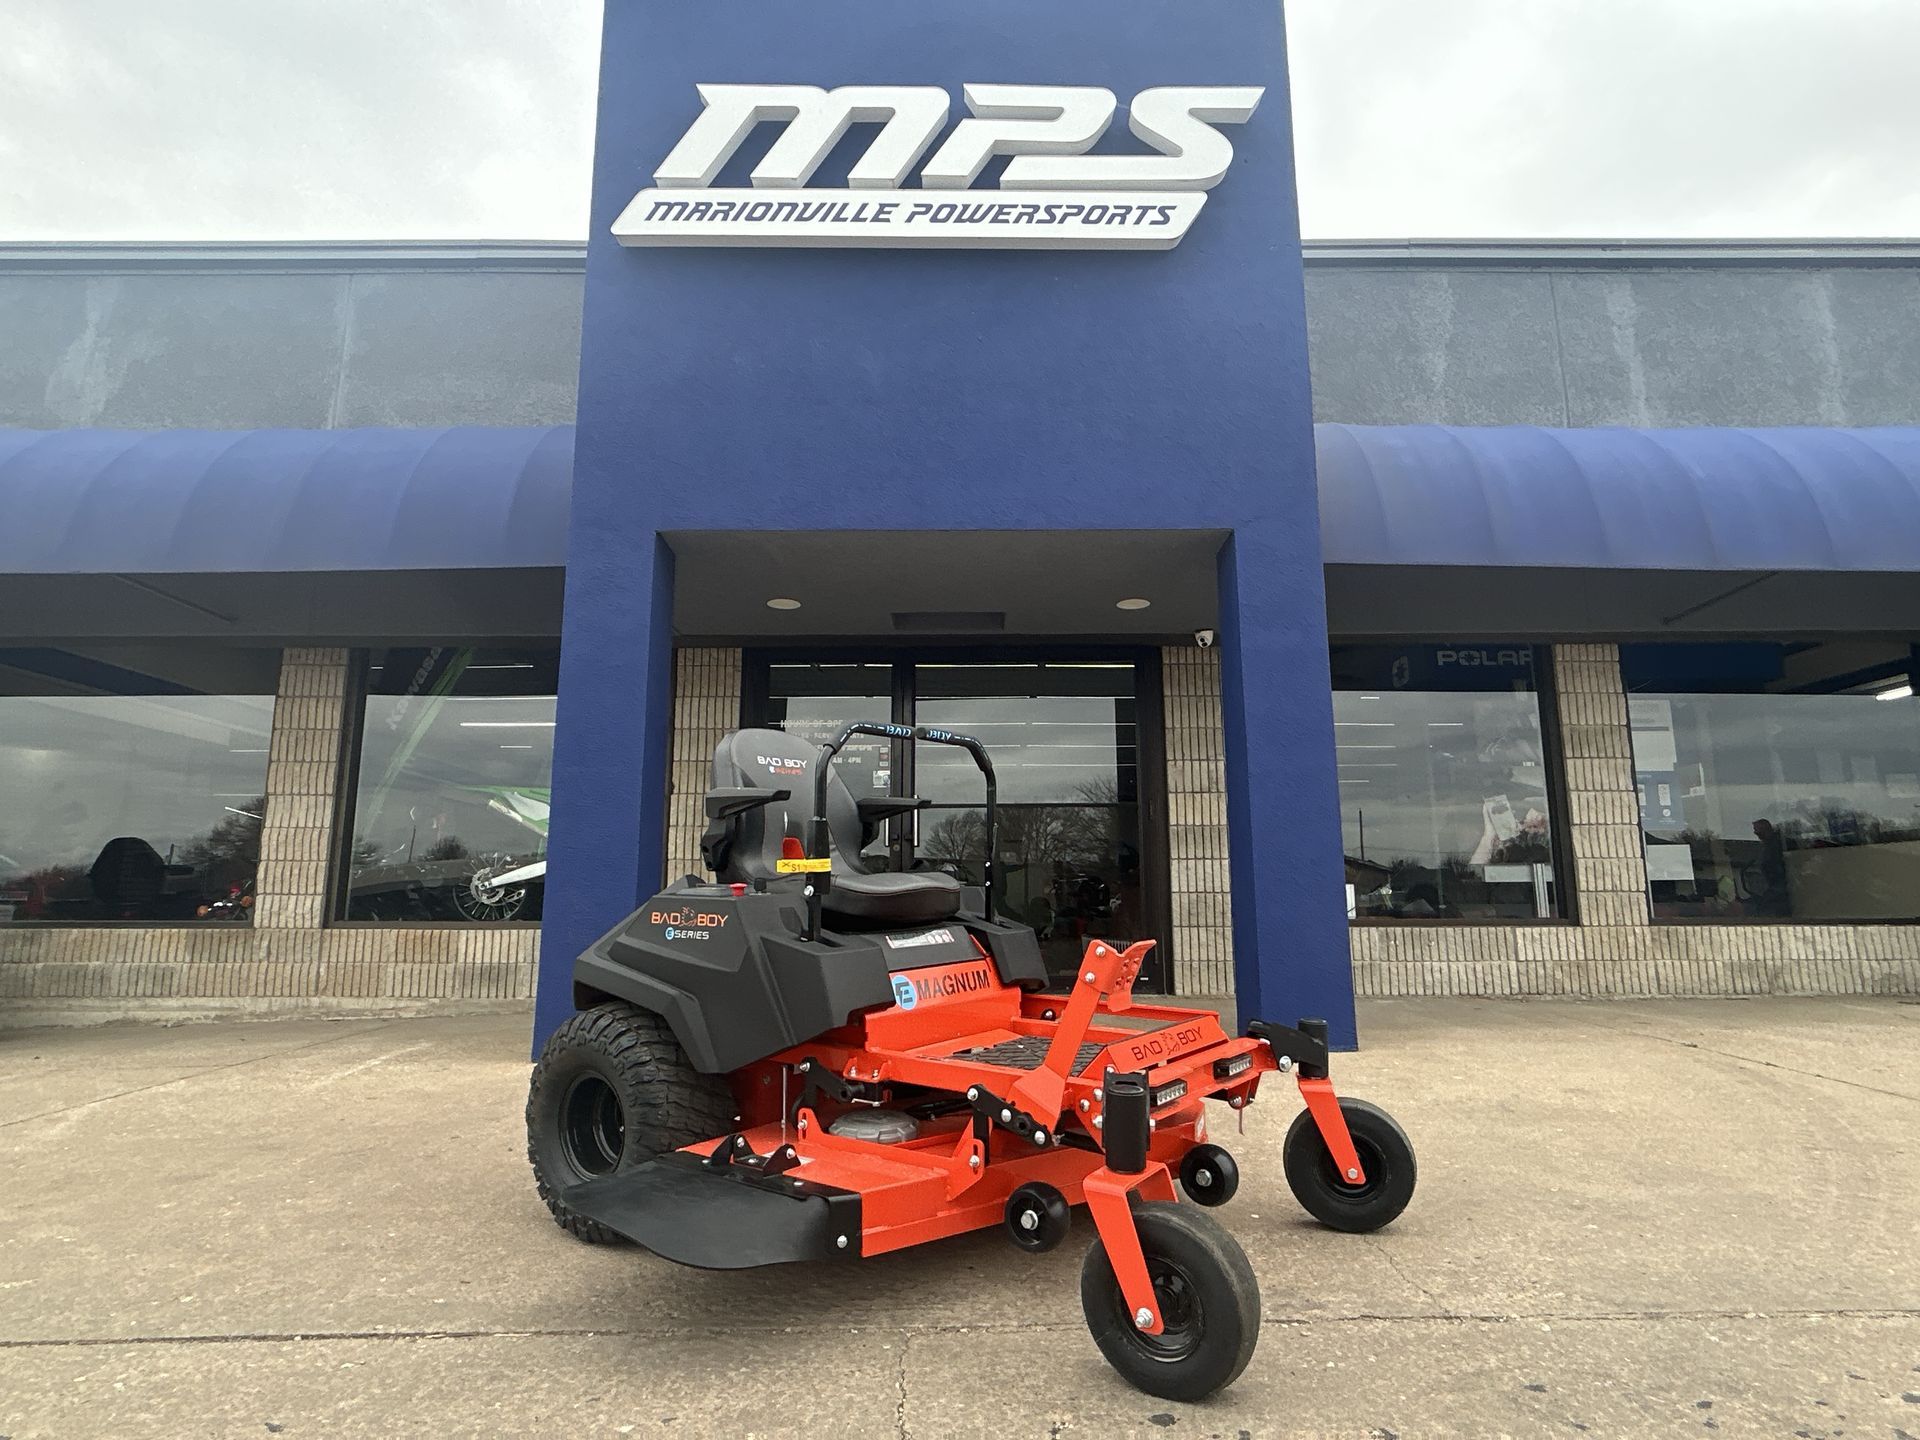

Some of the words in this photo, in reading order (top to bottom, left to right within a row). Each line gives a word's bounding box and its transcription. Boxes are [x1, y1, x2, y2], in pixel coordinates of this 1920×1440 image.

[653, 83, 1266, 190] MPS
[645, 201, 900, 224] MARIONVILLE
[904, 203, 1178, 226] POWERSPORTS
[757, 755, 781, 766] BAD
[784, 758, 807, 769] BOY
[651, 912, 680, 925] BAD
[697, 913, 728, 927] BOY
[674, 930, 710, 940] SERIES
[914, 969, 991, 1001] MAGNUM
[1131, 1040, 1163, 1061] BAD
[1176, 1026, 1203, 1046] BOY
